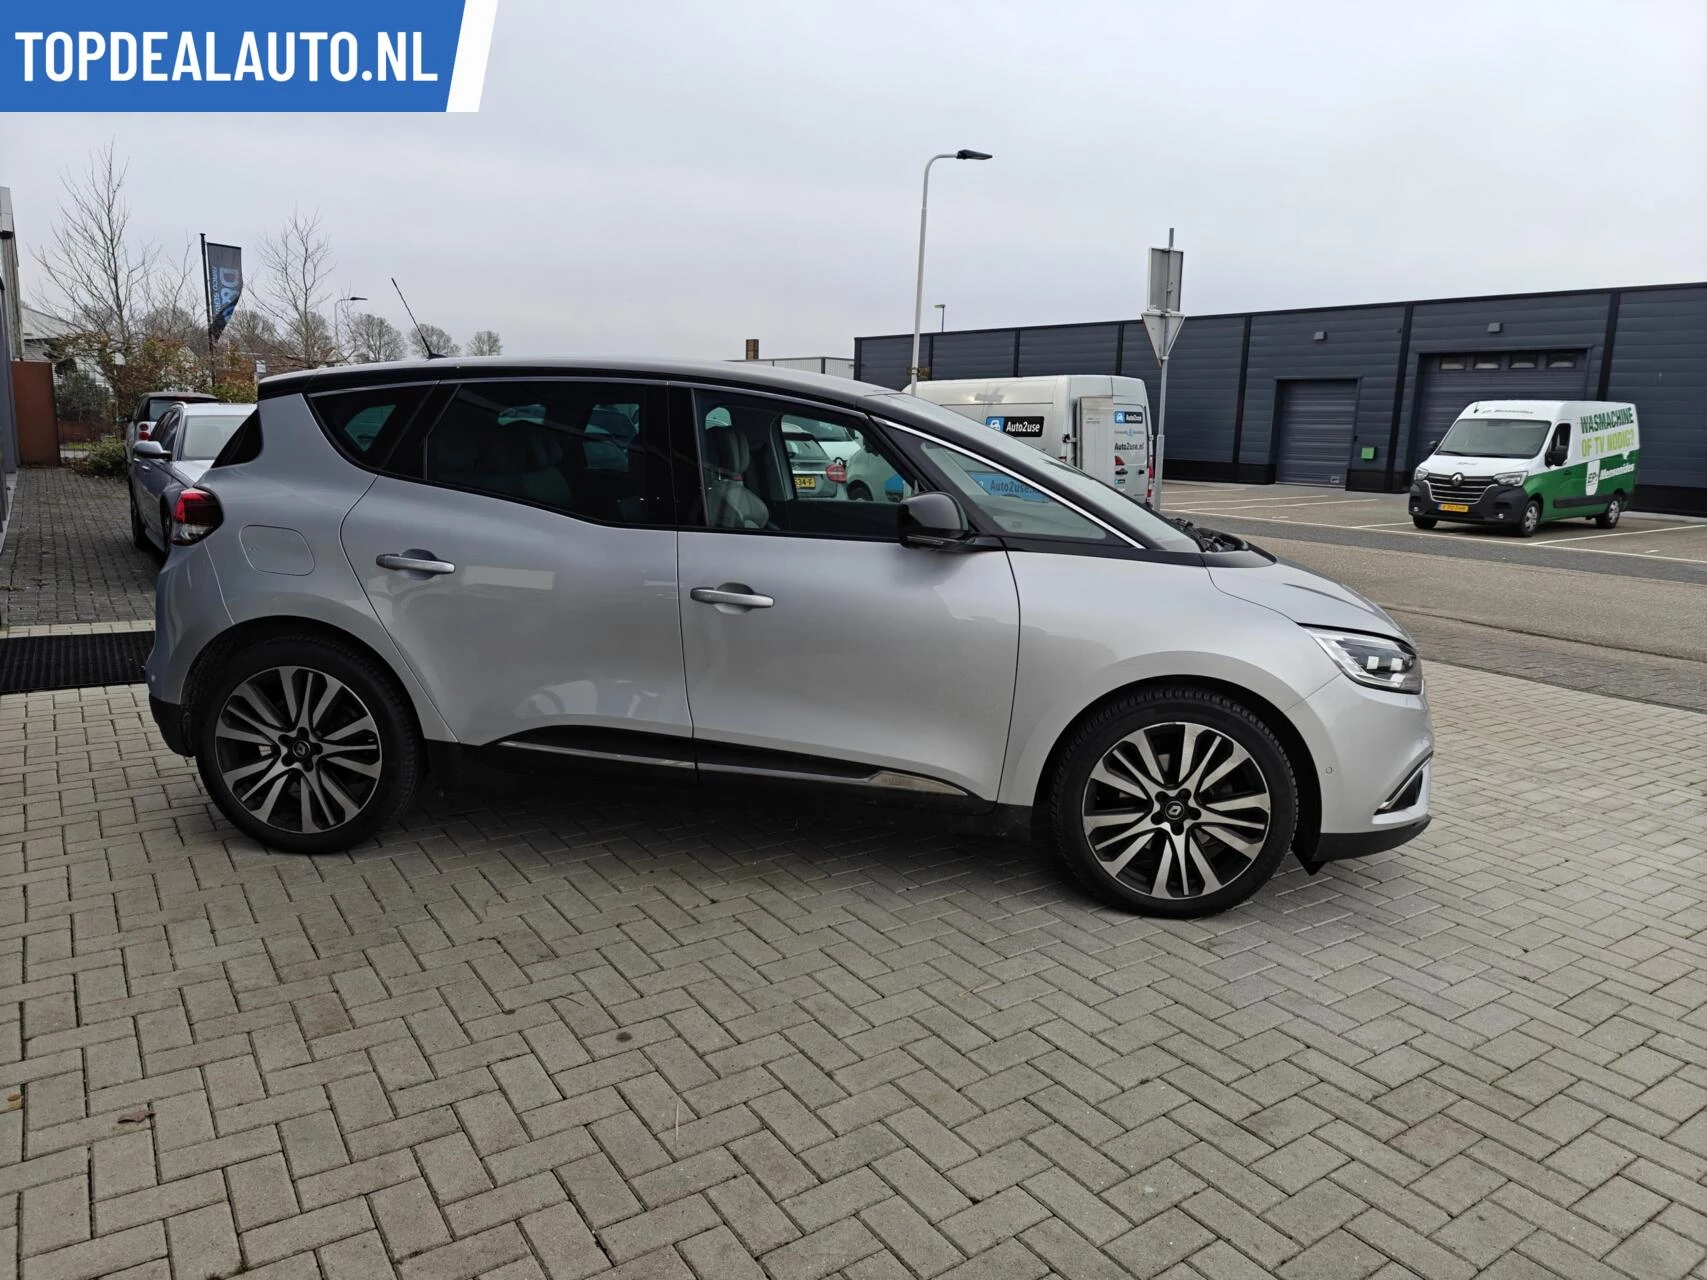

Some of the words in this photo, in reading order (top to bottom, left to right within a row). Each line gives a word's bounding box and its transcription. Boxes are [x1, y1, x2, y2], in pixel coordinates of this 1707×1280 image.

[1006, 421, 1040, 432] Auto2use
[1580, 407, 1634, 434] WASMACHINE
[1114, 442, 1144, 451] Auto2use.nl
[1582, 438, 1592, 457] OF
[1594, 436, 1604, 454] TV
[1608, 429, 1634, 451] NODIG?
